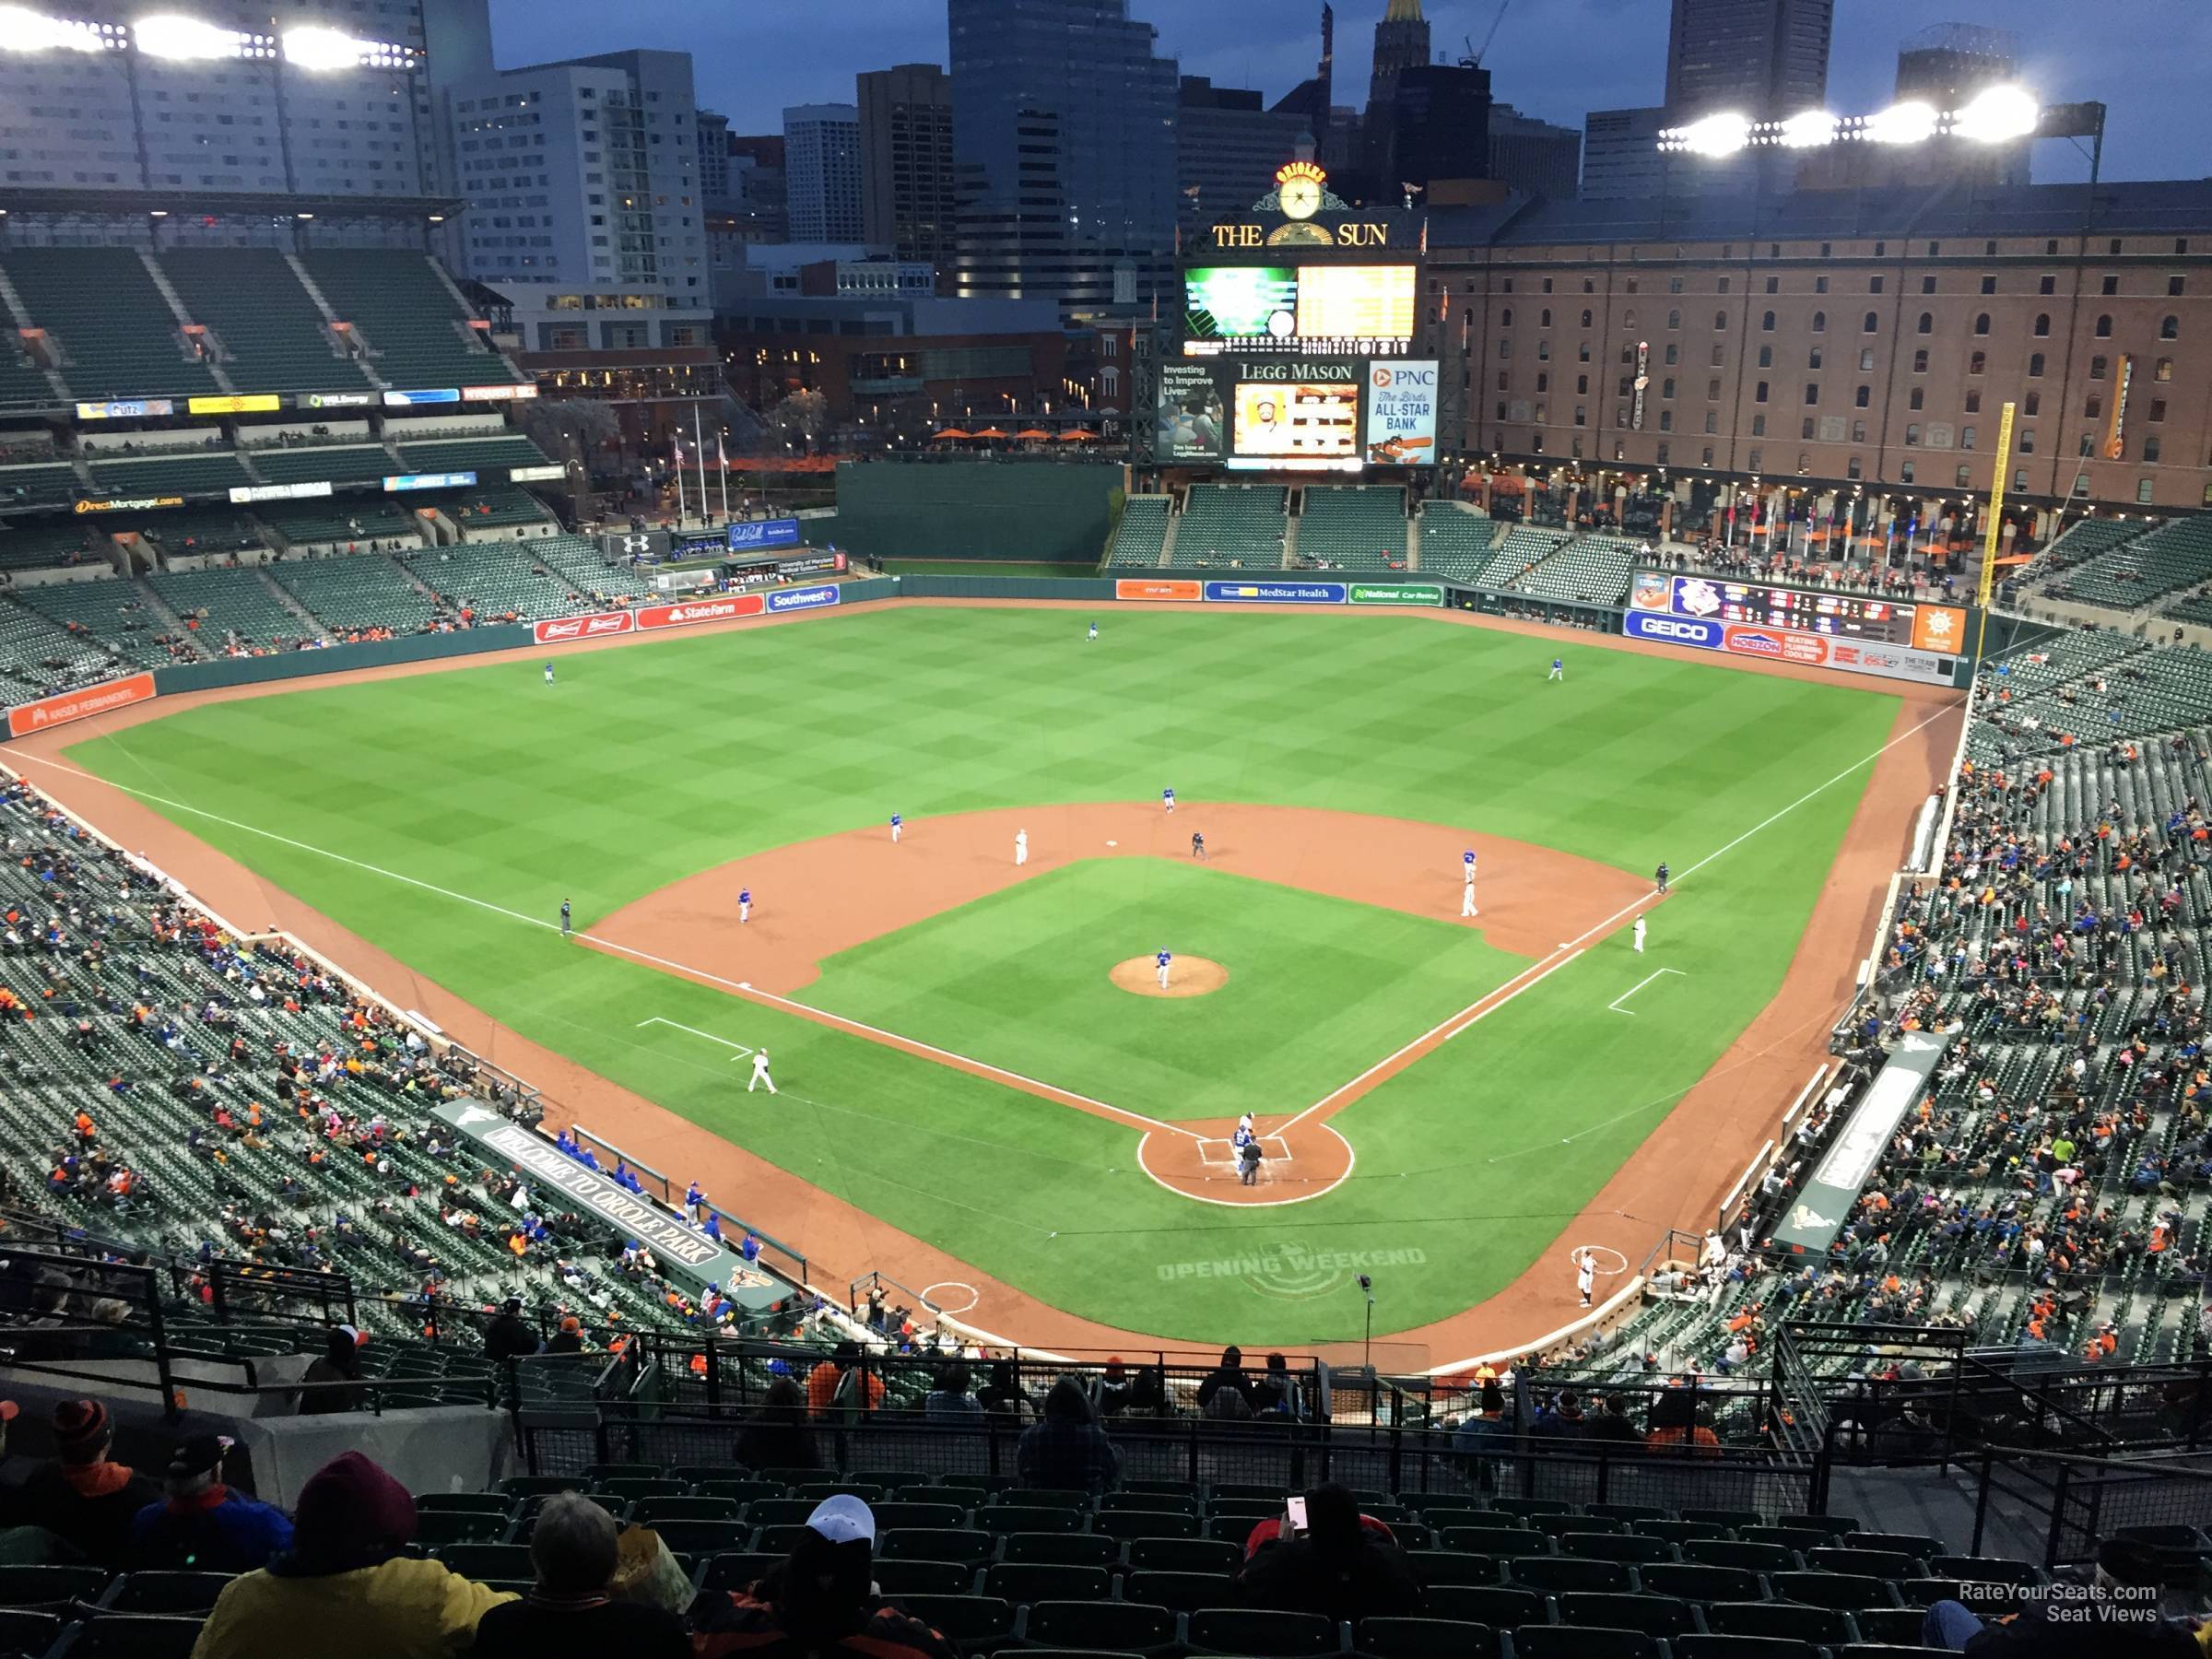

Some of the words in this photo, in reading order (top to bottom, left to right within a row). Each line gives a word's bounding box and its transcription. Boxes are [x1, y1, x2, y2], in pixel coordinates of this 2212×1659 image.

[1277, 161, 1325, 182] ORIOLES
[1212, 225, 1263, 247] THE
[1337, 223, 1388, 247] SUN
[1163, 365, 1206, 376] Investing
[1241, 363, 1287, 380] LEGG
[1291, 362, 1353, 380] MASON
[1163, 376, 1174, 384] to
[1176, 375, 1214, 386] Improve
[1394, 371, 1435, 386] PNC
[1163, 387, 1187, 395] Lives
[1379, 391, 1397, 402] The
[1399, 391, 1427, 402] Birds
[1375, 404, 1430, 416] ALL-STAR
[1387, 418, 1417, 430] BANK
[779, 560, 804, 569] University
[812, 557, 834, 565] Maryland
[773, 591, 826, 607] Southwest
[1259, 588, 1295, 597] MedStar
[1298, 588, 1328, 598] Health
[1365, 589, 1399, 598] National
[1419, 592, 1439, 600] Rental
[1641, 618, 1708, 641] GEICO
[1732, 637, 1780, 652] HORIZON
[1785, 635, 1818, 646] HEATING
[1784, 643, 1823, 654] PLUMBING
[1783, 650, 1817, 661] COOLING
[50, 703, 77, 720] KAISER
[79, 689, 135, 712] PERMANENTE
[495, 1128, 575, 1180] WELCOME
[571, 1174, 597, 1194] TO
[594, 1189, 662, 1235] ORIOLE
[657, 1228, 715, 1264] PARK
[1157, 1258, 1281, 1280] OPENING
[1288, 1248, 1427, 1271] WEEKEND
